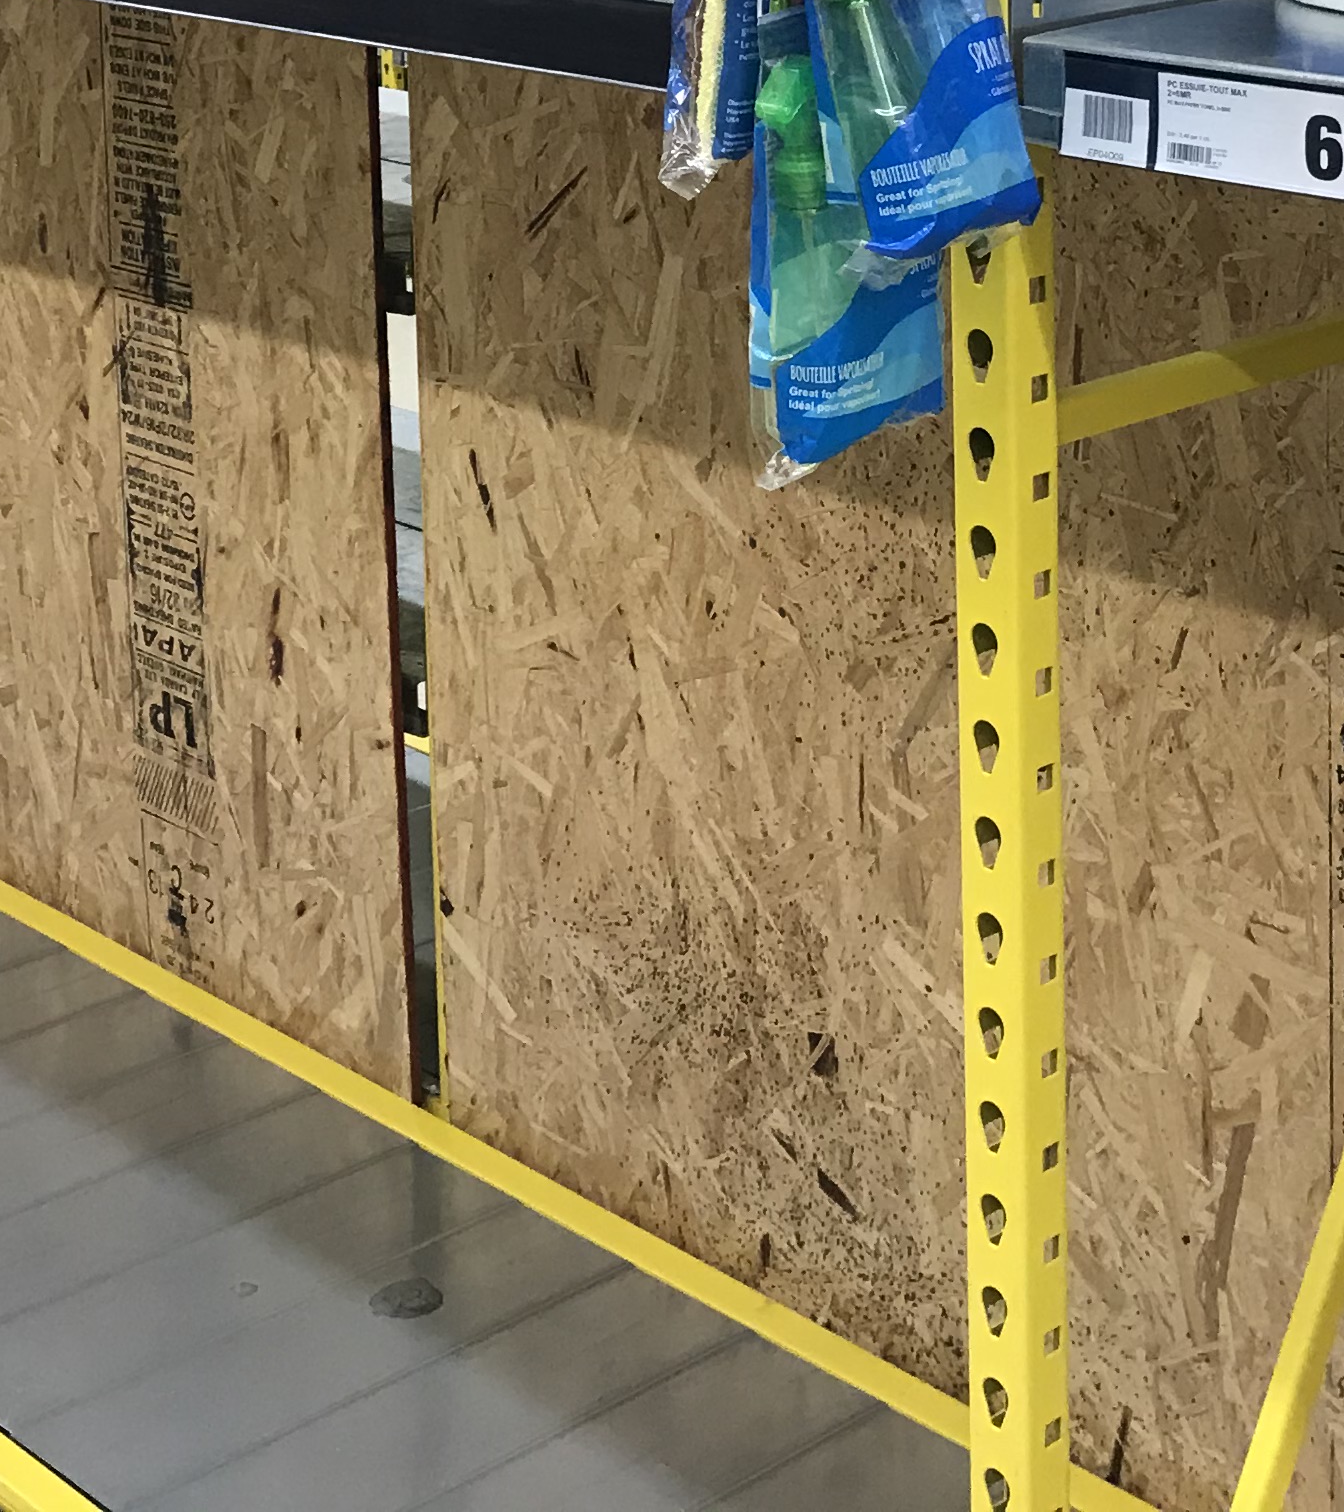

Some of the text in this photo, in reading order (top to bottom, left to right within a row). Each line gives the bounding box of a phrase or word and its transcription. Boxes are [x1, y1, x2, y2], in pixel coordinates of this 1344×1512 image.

[968, 37, 1001, 73] SPRAY
[1167, 80, 1177, 88] PC
[1230, 89, 1247, 97] MAX
[871, 160, 920, 187] BOUTEILLE
[876, 186, 924, 203] Great for
[879, 201, 932, 216] Idéal pour
[791, 365, 836, 383] BOUTEILLE
[789, 386, 818, 398] Great
[789, 400, 814, 411] Idéal
[149, 692, 197, 749] LP
